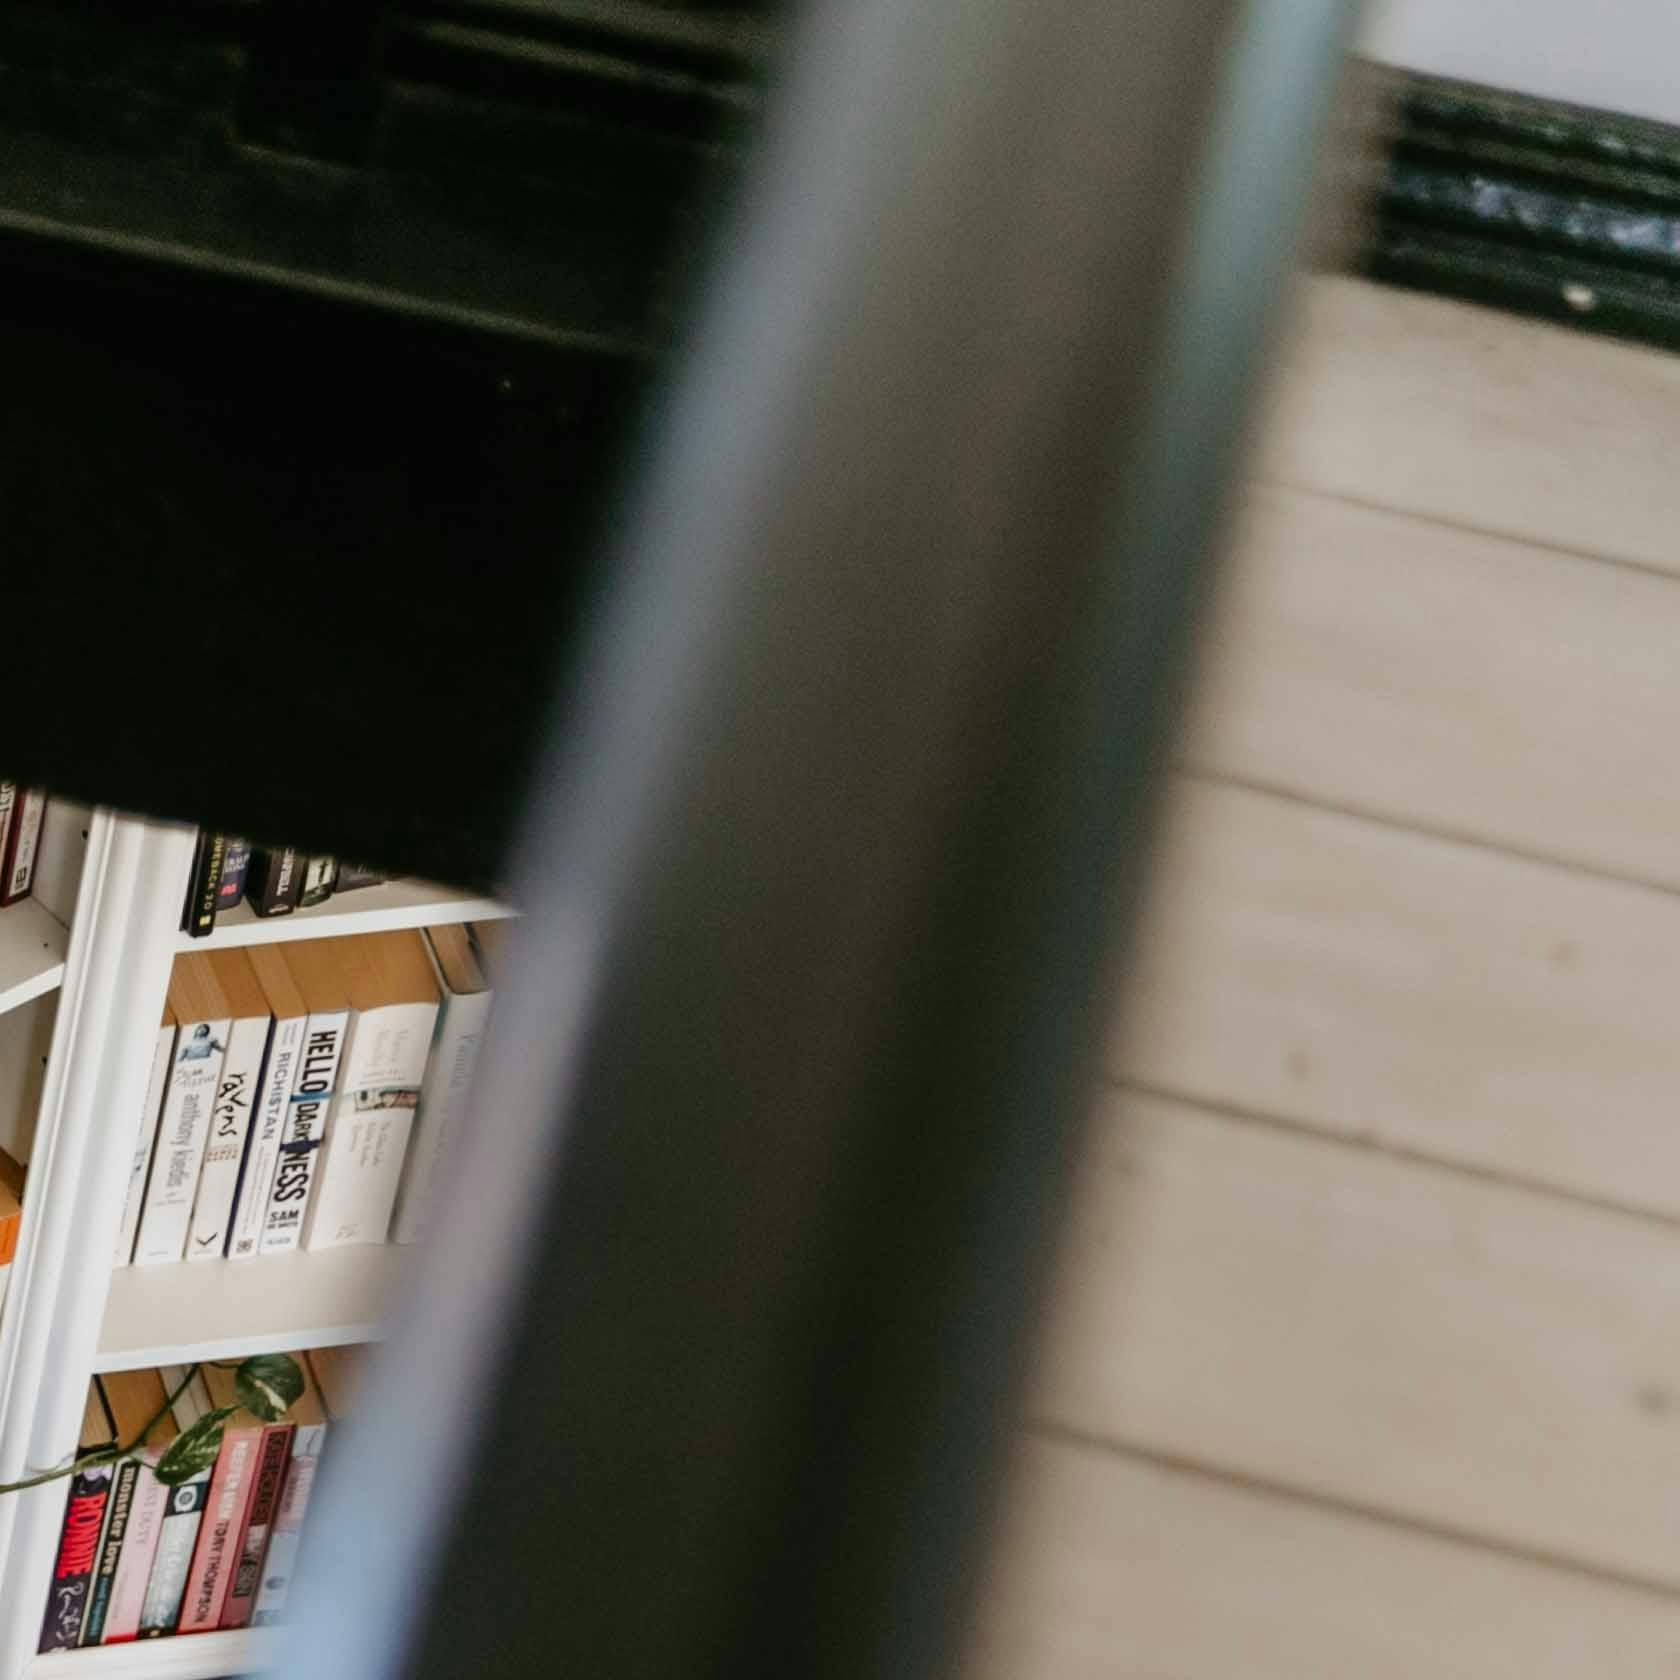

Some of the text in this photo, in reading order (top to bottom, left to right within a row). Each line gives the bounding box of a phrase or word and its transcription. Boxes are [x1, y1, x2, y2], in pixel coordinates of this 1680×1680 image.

[261, 1052, 292, 1141] RICHISTAN
[299, 1029, 338, 1094] HELLO
[274, 1149, 312, 1202] NESS
[57, 1491, 107, 1581] RONNIE
[102, 1467, 135, 1575] monster love
[194, 1555, 221, 1623] THOMPSON
